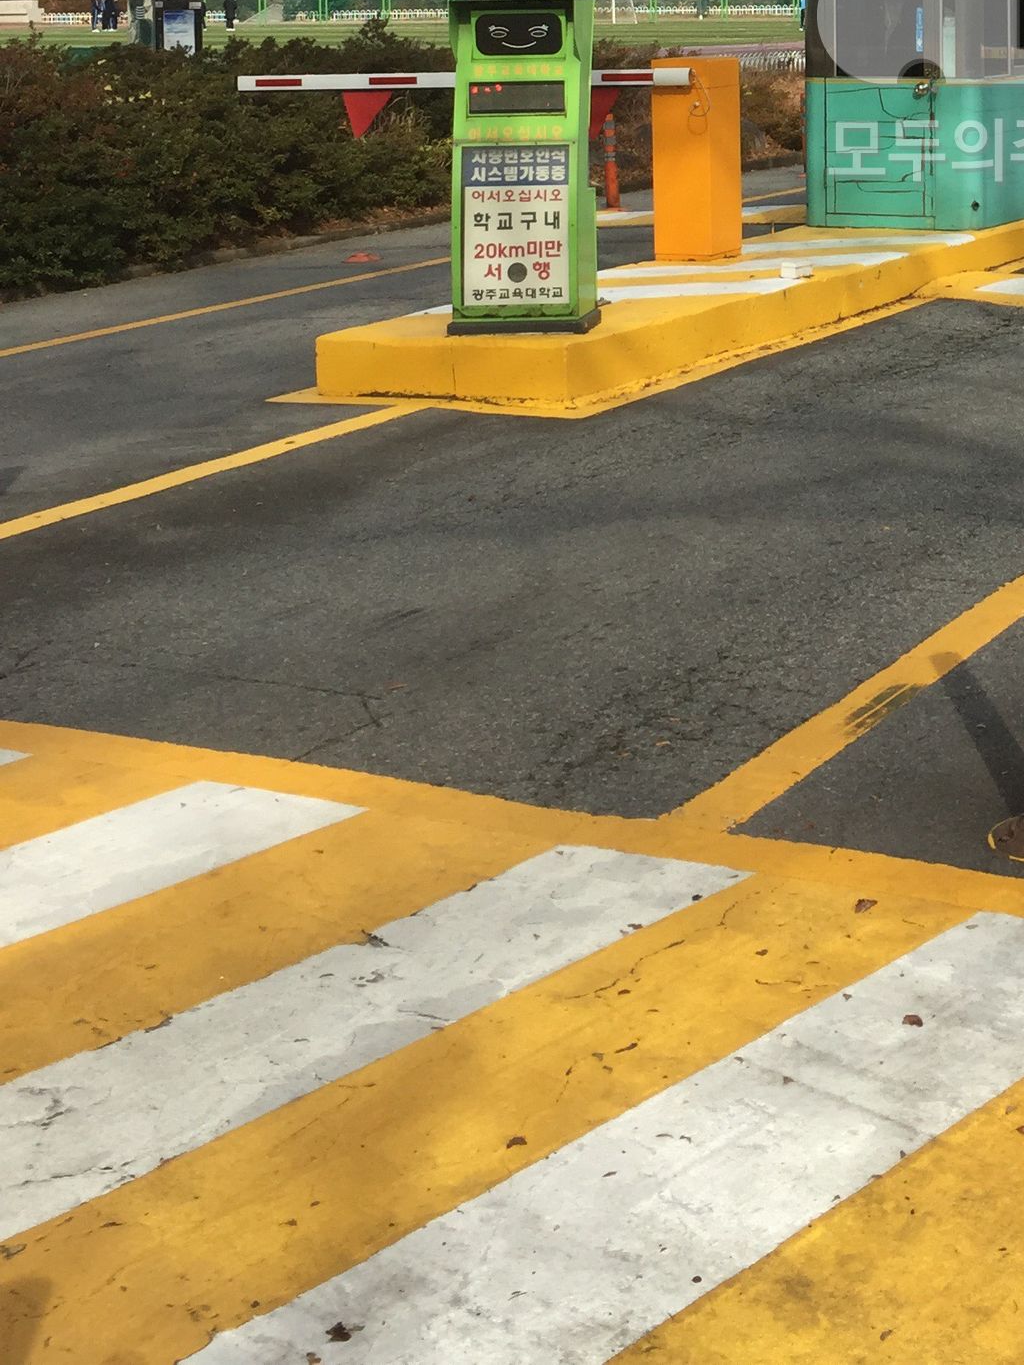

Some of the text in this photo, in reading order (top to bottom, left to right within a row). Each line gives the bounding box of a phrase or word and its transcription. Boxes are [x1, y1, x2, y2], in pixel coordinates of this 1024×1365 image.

[471, 146, 565, 165] 차량번호인식
[471, 165, 566, 182] 시스템가동중
[471, 189, 563, 203] 어서오십시오
[474, 240, 562, 259] 20km미만
[472, 287, 563, 301] 광주교육대학교
